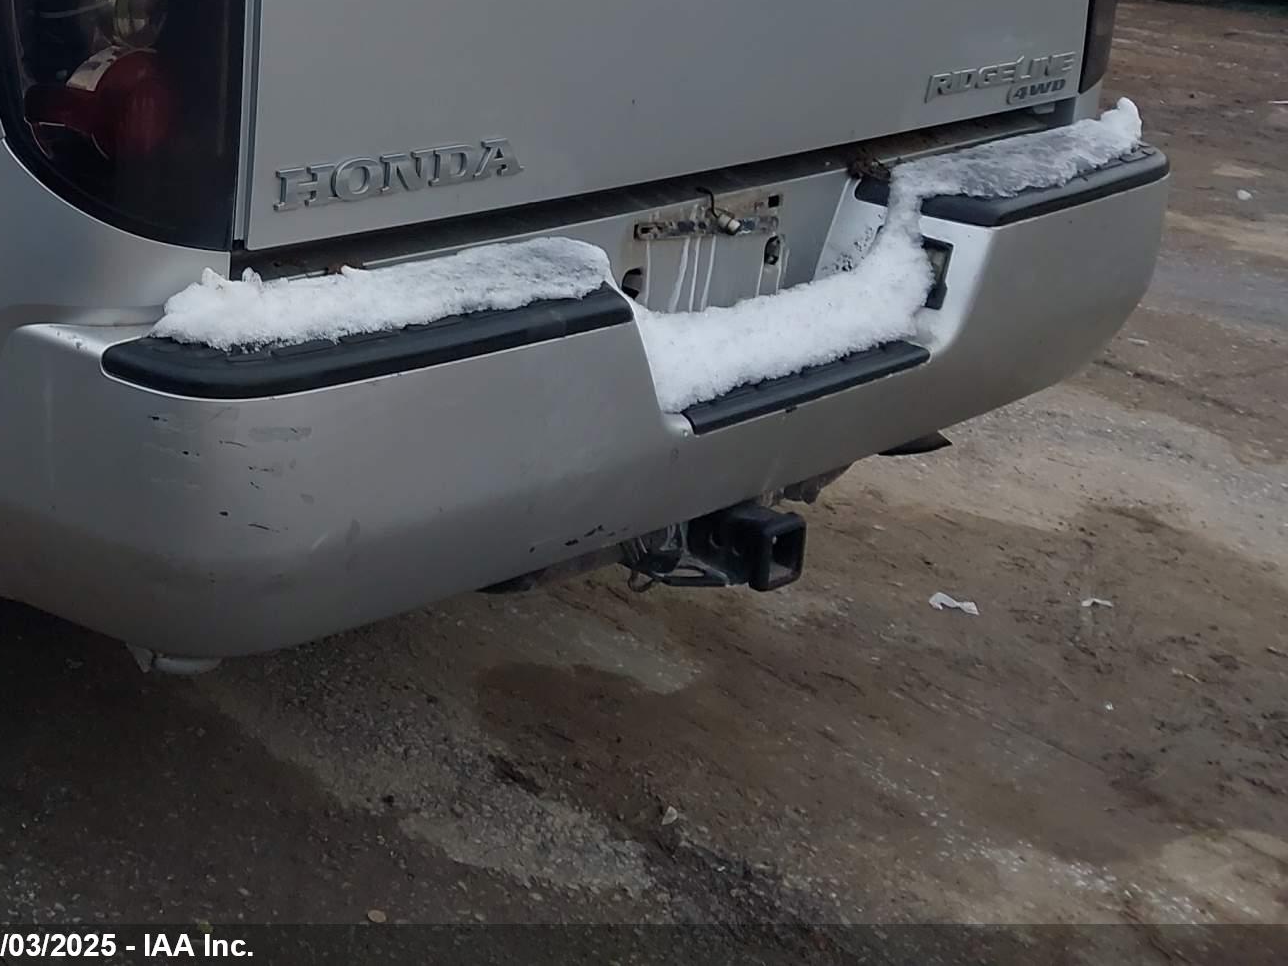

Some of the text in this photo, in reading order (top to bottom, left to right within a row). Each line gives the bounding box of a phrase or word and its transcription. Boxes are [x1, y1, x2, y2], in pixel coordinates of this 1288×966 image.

[923, 51, 1077, 104] RIDGELINE
[1012, 79, 1066, 101] 4WD
[273, 137, 524, 212] HONDA
